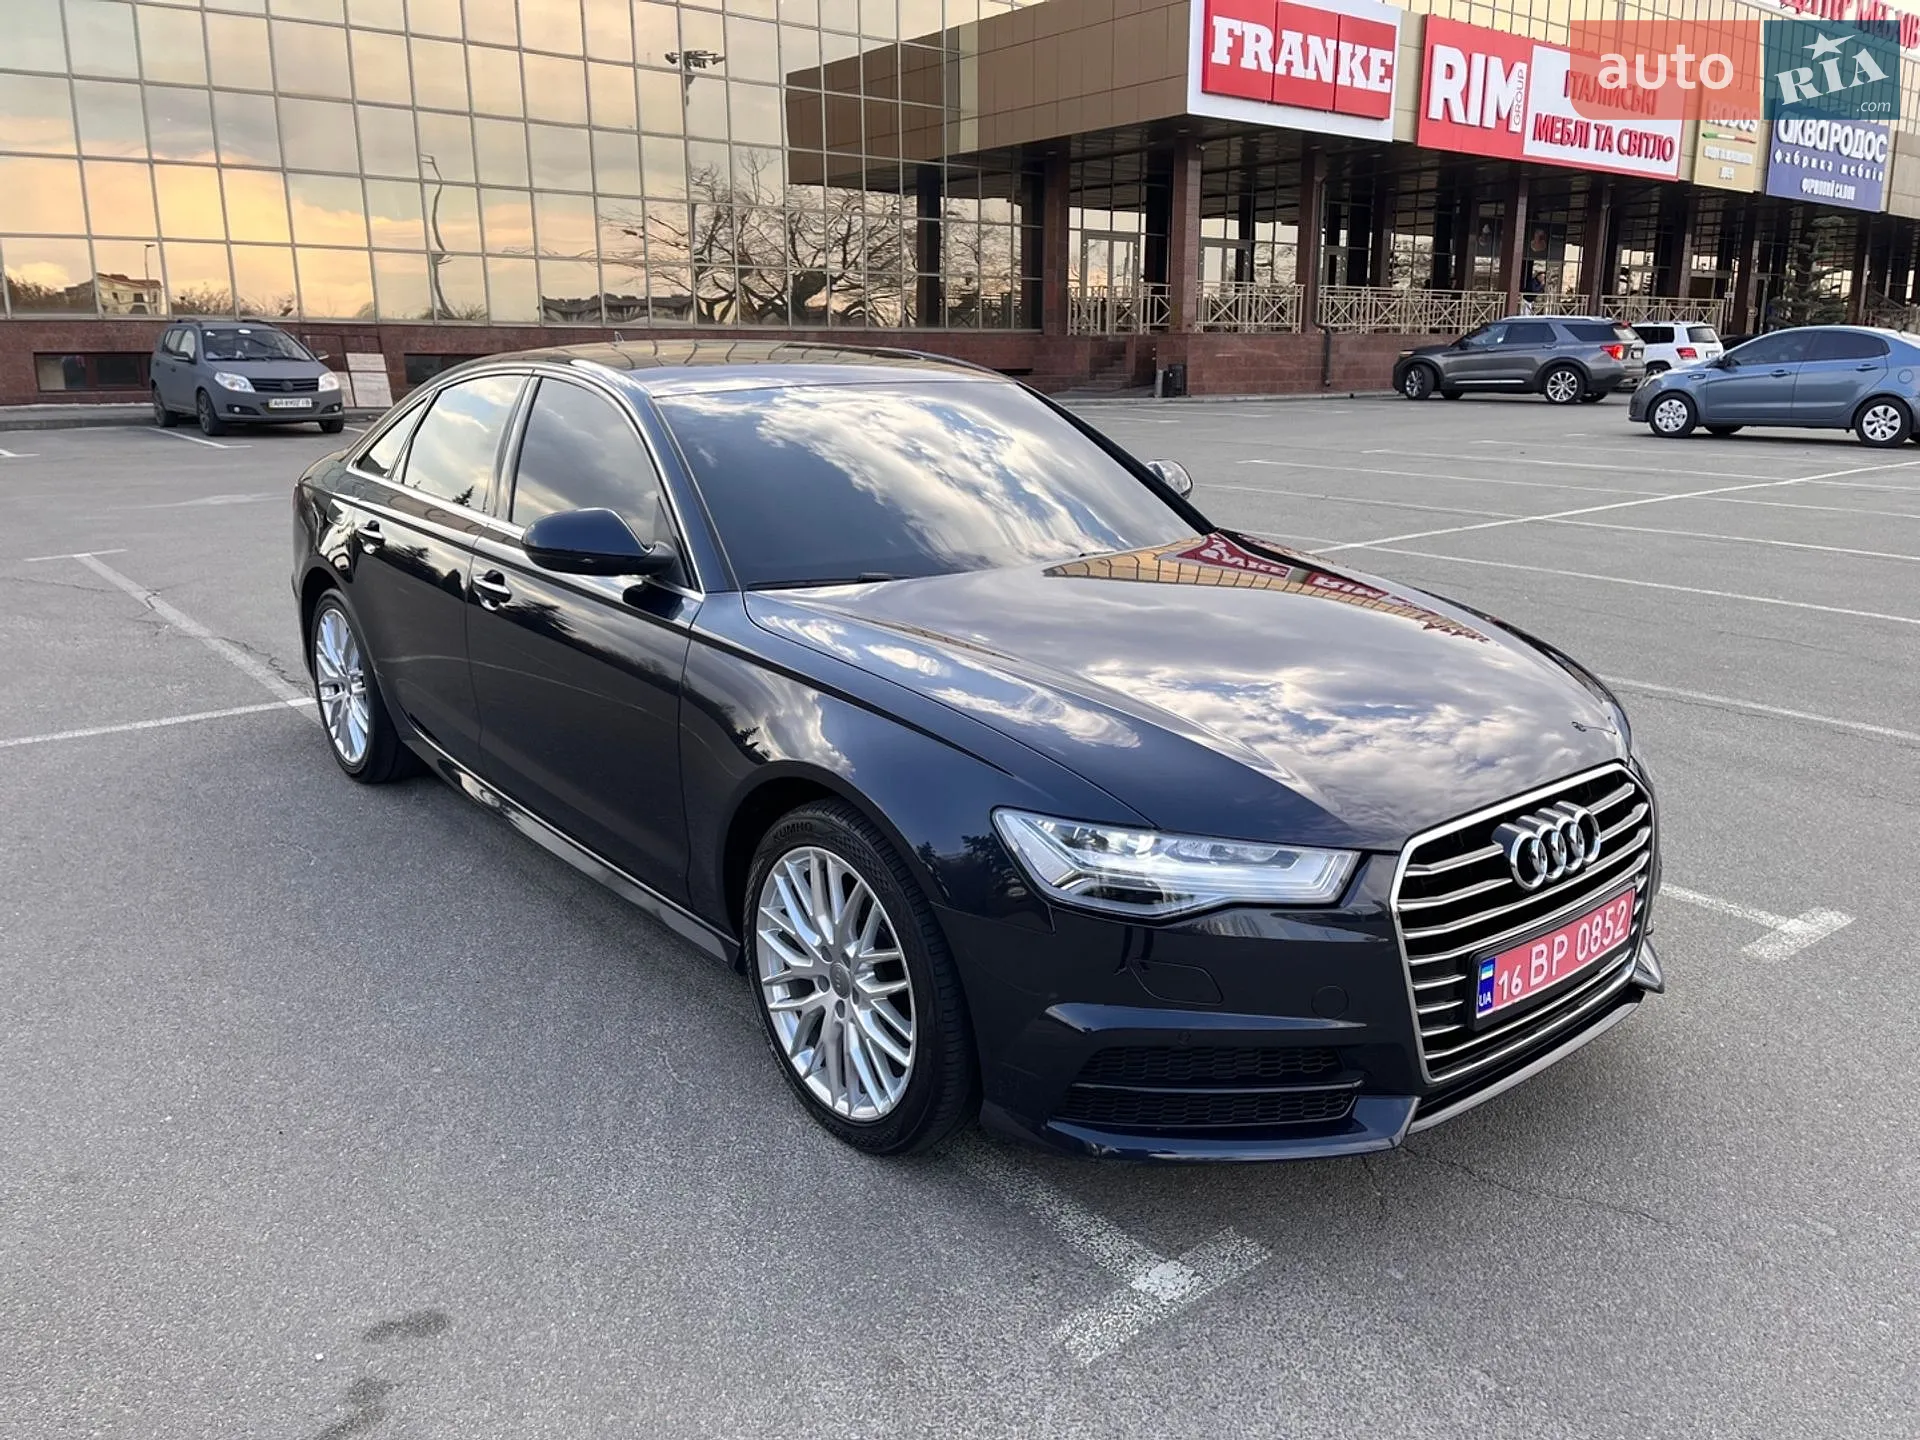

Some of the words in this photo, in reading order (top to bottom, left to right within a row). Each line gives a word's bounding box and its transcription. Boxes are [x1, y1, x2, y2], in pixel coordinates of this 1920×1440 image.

[1211, 15, 1394, 93] FRANKE
[1427, 44, 1528, 134] RIM
[1513, 69, 1526, 126] GROUP
[1532, 112, 1591, 150] МЕБЛІ
[1594, 123, 1614, 153] ТА
[1617, 128, 1675, 163] СВІТЛО
[1498, 964, 1523, 1001] 16
[1529, 933, 1569, 988] BP
[1575, 899, 1628, 962] 0852
[1478, 993, 1492, 1008] UA
